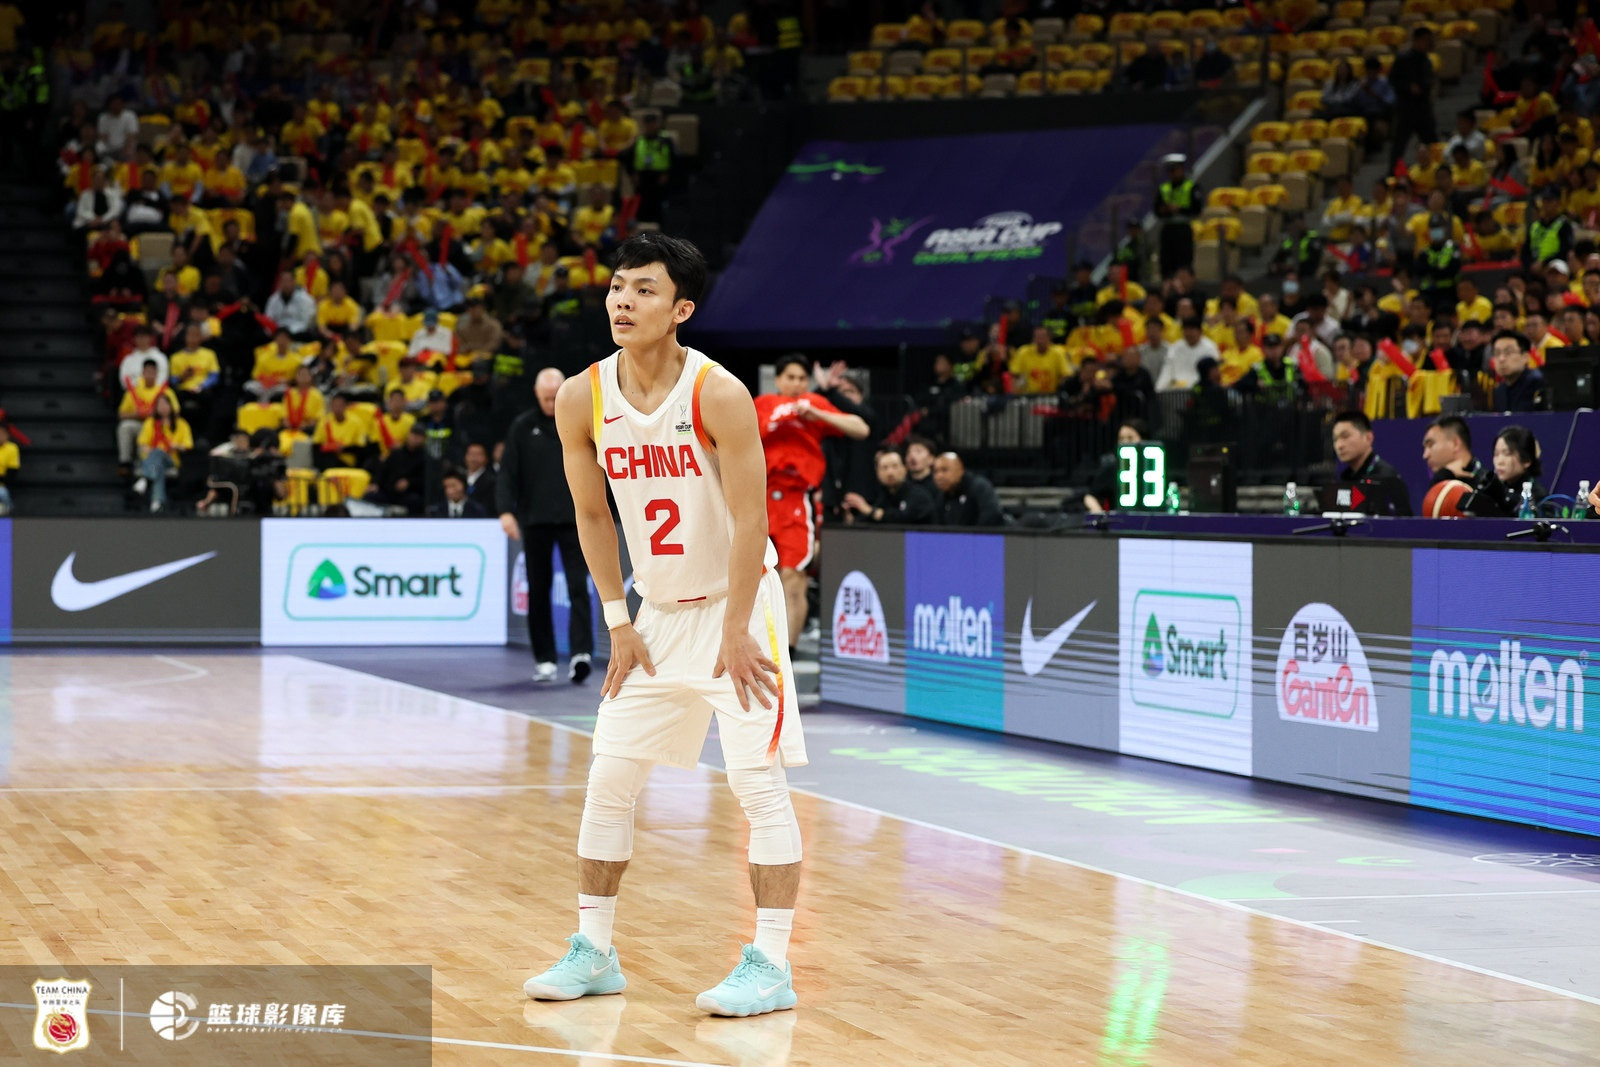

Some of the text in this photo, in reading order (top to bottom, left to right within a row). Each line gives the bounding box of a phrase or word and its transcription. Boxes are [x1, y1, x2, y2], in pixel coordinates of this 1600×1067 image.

[604, 444, 703, 480] CHINA
[1119, 446, 1165, 507] 33
[644, 498, 685, 556] 2
[353, 566, 463, 598] Smart
[913, 595, 994, 659] molten
[1166, 623, 1228, 681] Smart
[1293, 622, 1349, 665] 百岁山
[1428, 638, 1585, 734] molten
